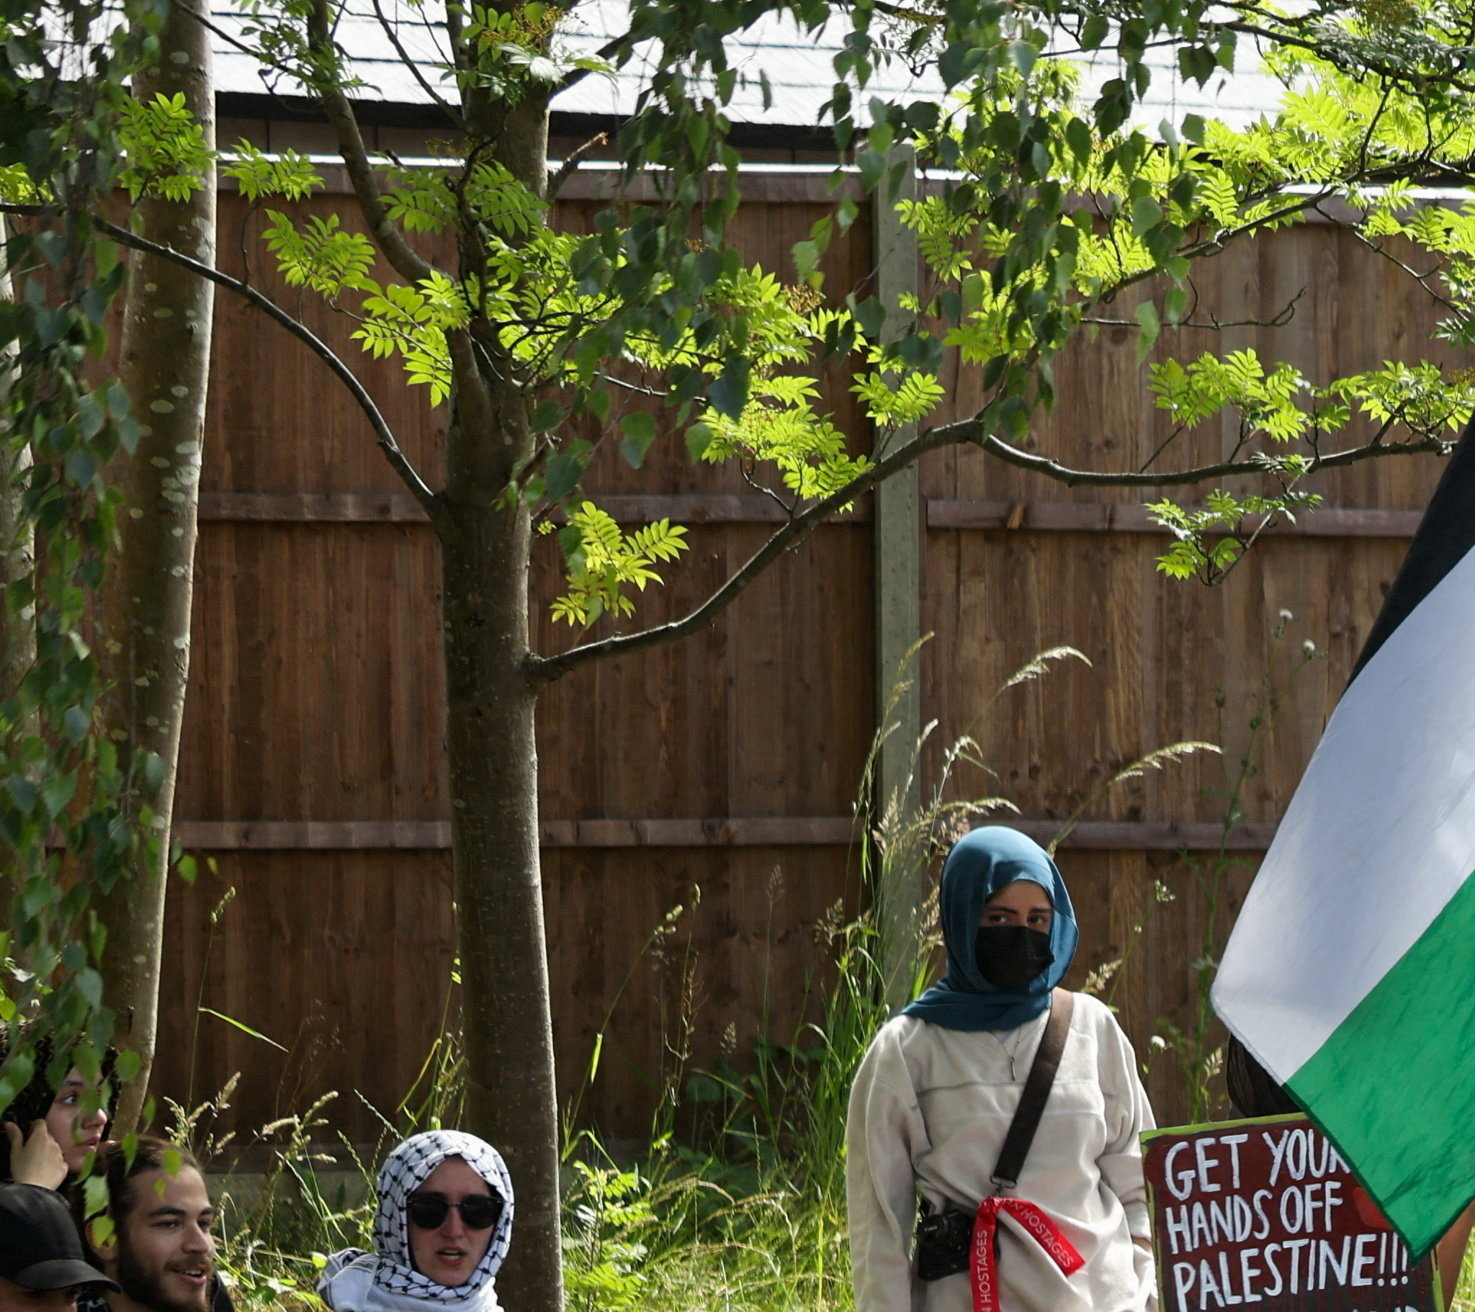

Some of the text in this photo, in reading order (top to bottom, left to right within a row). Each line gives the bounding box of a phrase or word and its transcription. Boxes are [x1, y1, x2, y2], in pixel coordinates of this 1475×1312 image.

[1165, 1133, 1249, 1202] GET
[1020, 1209, 1075, 1268] HOSTAGES
[1166, 1181, 1343, 1255] HANDS OFF
[978, 1230, 991, 1303] HOSTAGES
